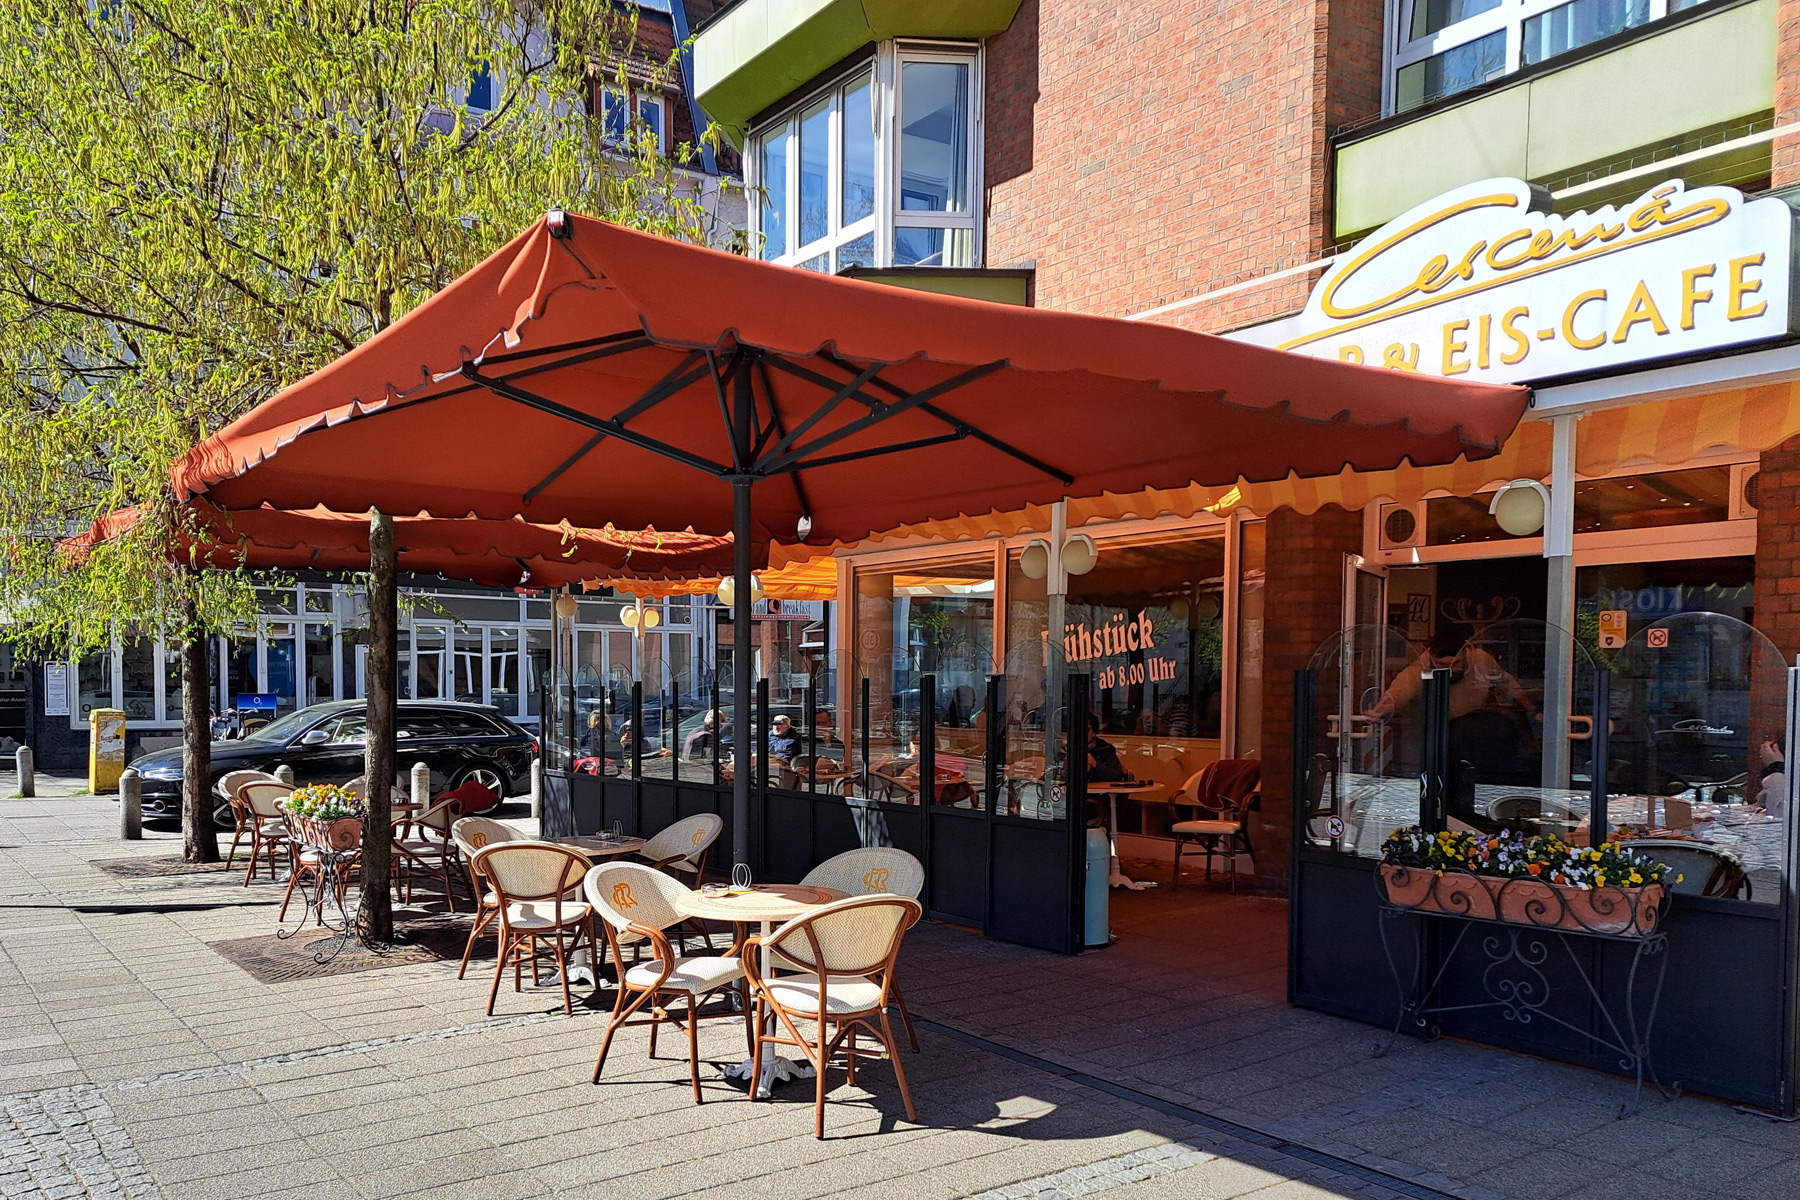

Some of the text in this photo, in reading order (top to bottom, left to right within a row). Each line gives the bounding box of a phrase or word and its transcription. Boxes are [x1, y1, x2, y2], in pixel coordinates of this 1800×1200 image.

[1441, 252, 1767, 377] EIS-CAFE
[1041, 609, 1155, 667] ühstück
[1099, 656, 1177, 690] ab 8.00 Uhr
